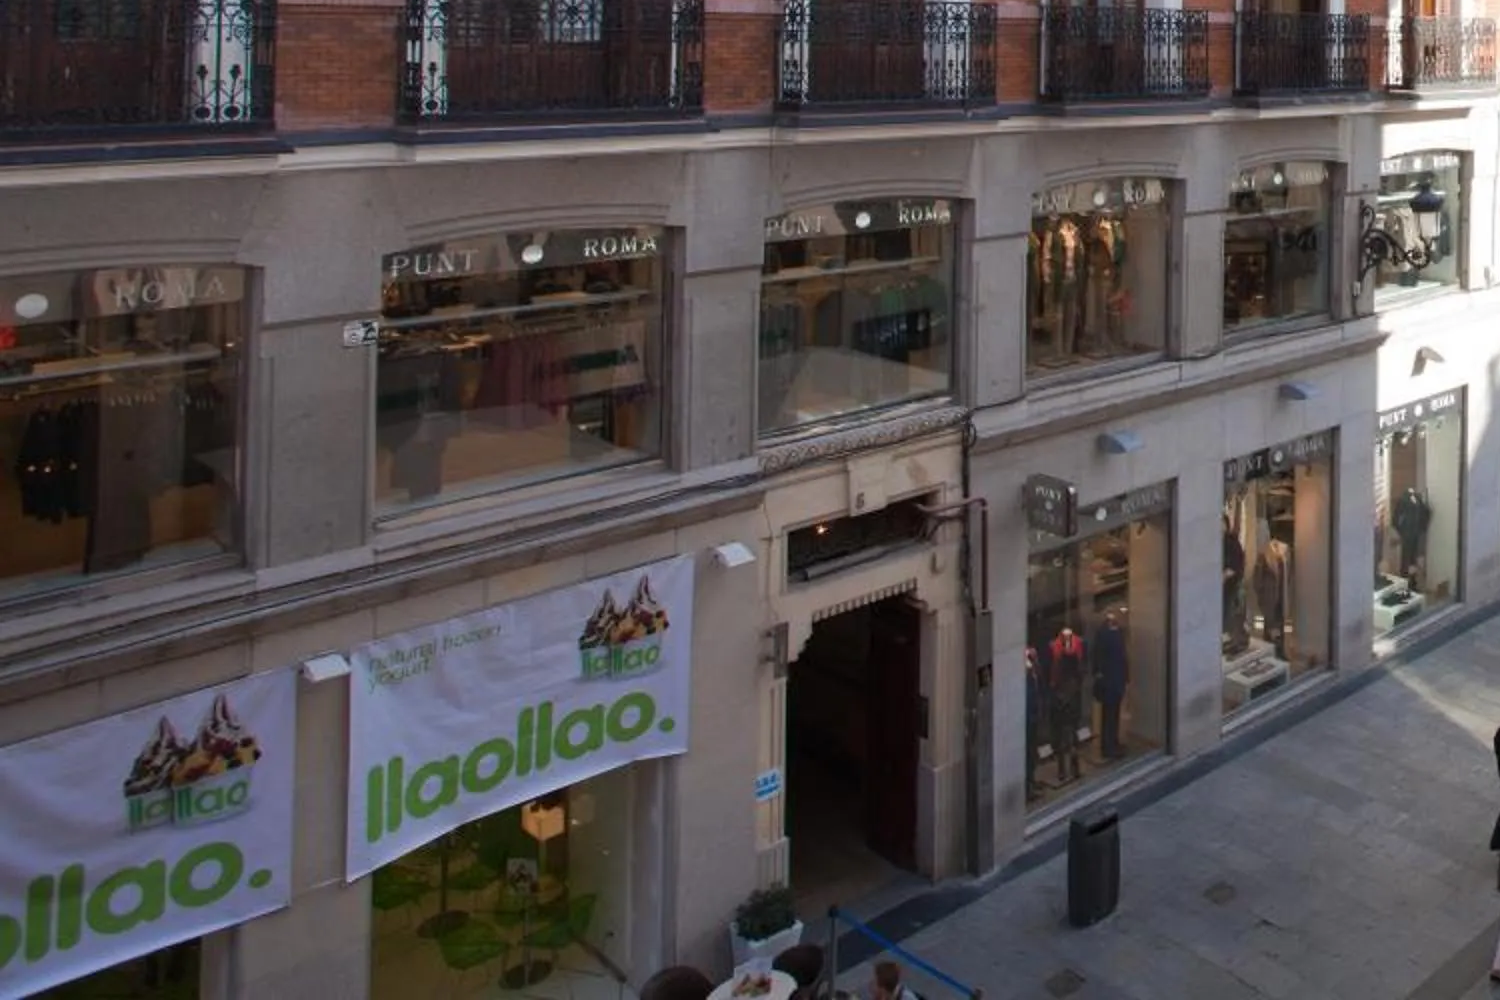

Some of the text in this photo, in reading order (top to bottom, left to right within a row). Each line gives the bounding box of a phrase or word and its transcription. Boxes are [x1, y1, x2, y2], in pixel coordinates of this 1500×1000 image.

[390, 235, 656, 277] PUNT ROMA
[899, 203, 952, 224] ROMA
[366, 692, 676, 844] llaollao.
[0, 841, 273, 971] llao.
